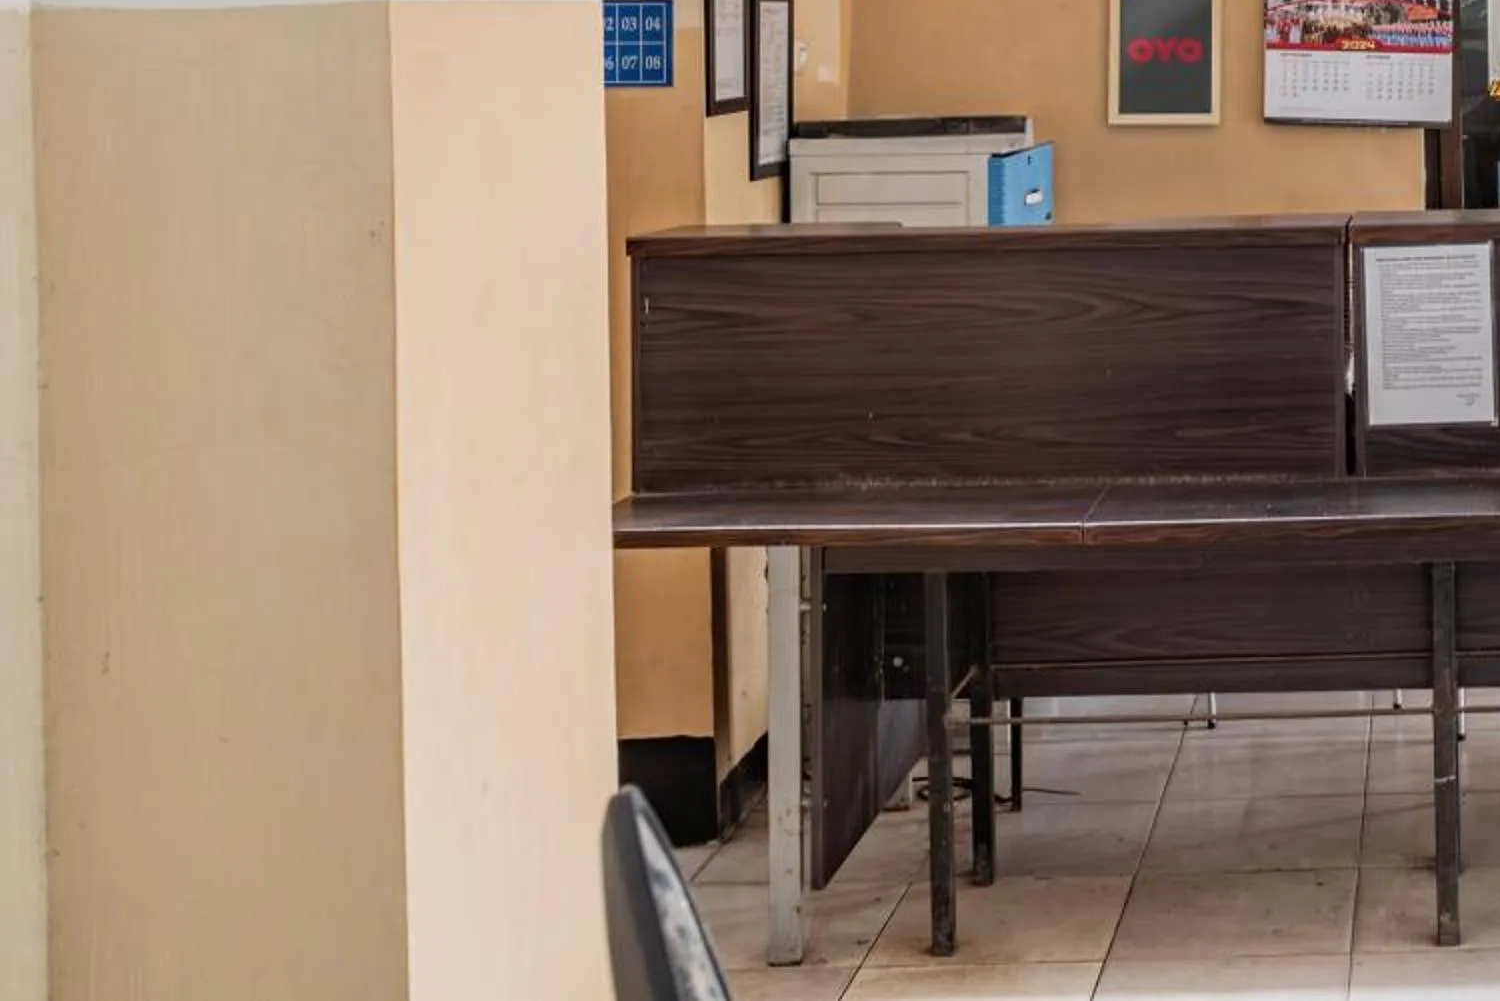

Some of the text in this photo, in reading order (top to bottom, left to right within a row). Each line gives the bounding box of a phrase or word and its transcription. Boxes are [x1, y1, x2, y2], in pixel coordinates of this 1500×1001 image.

[604, 16, 661, 31] 2 03 04
[1127, 36, 1204, 64] OYO
[1341, 39, 1376, 50] 2024
[604, 55, 661, 70] 6 07 08
